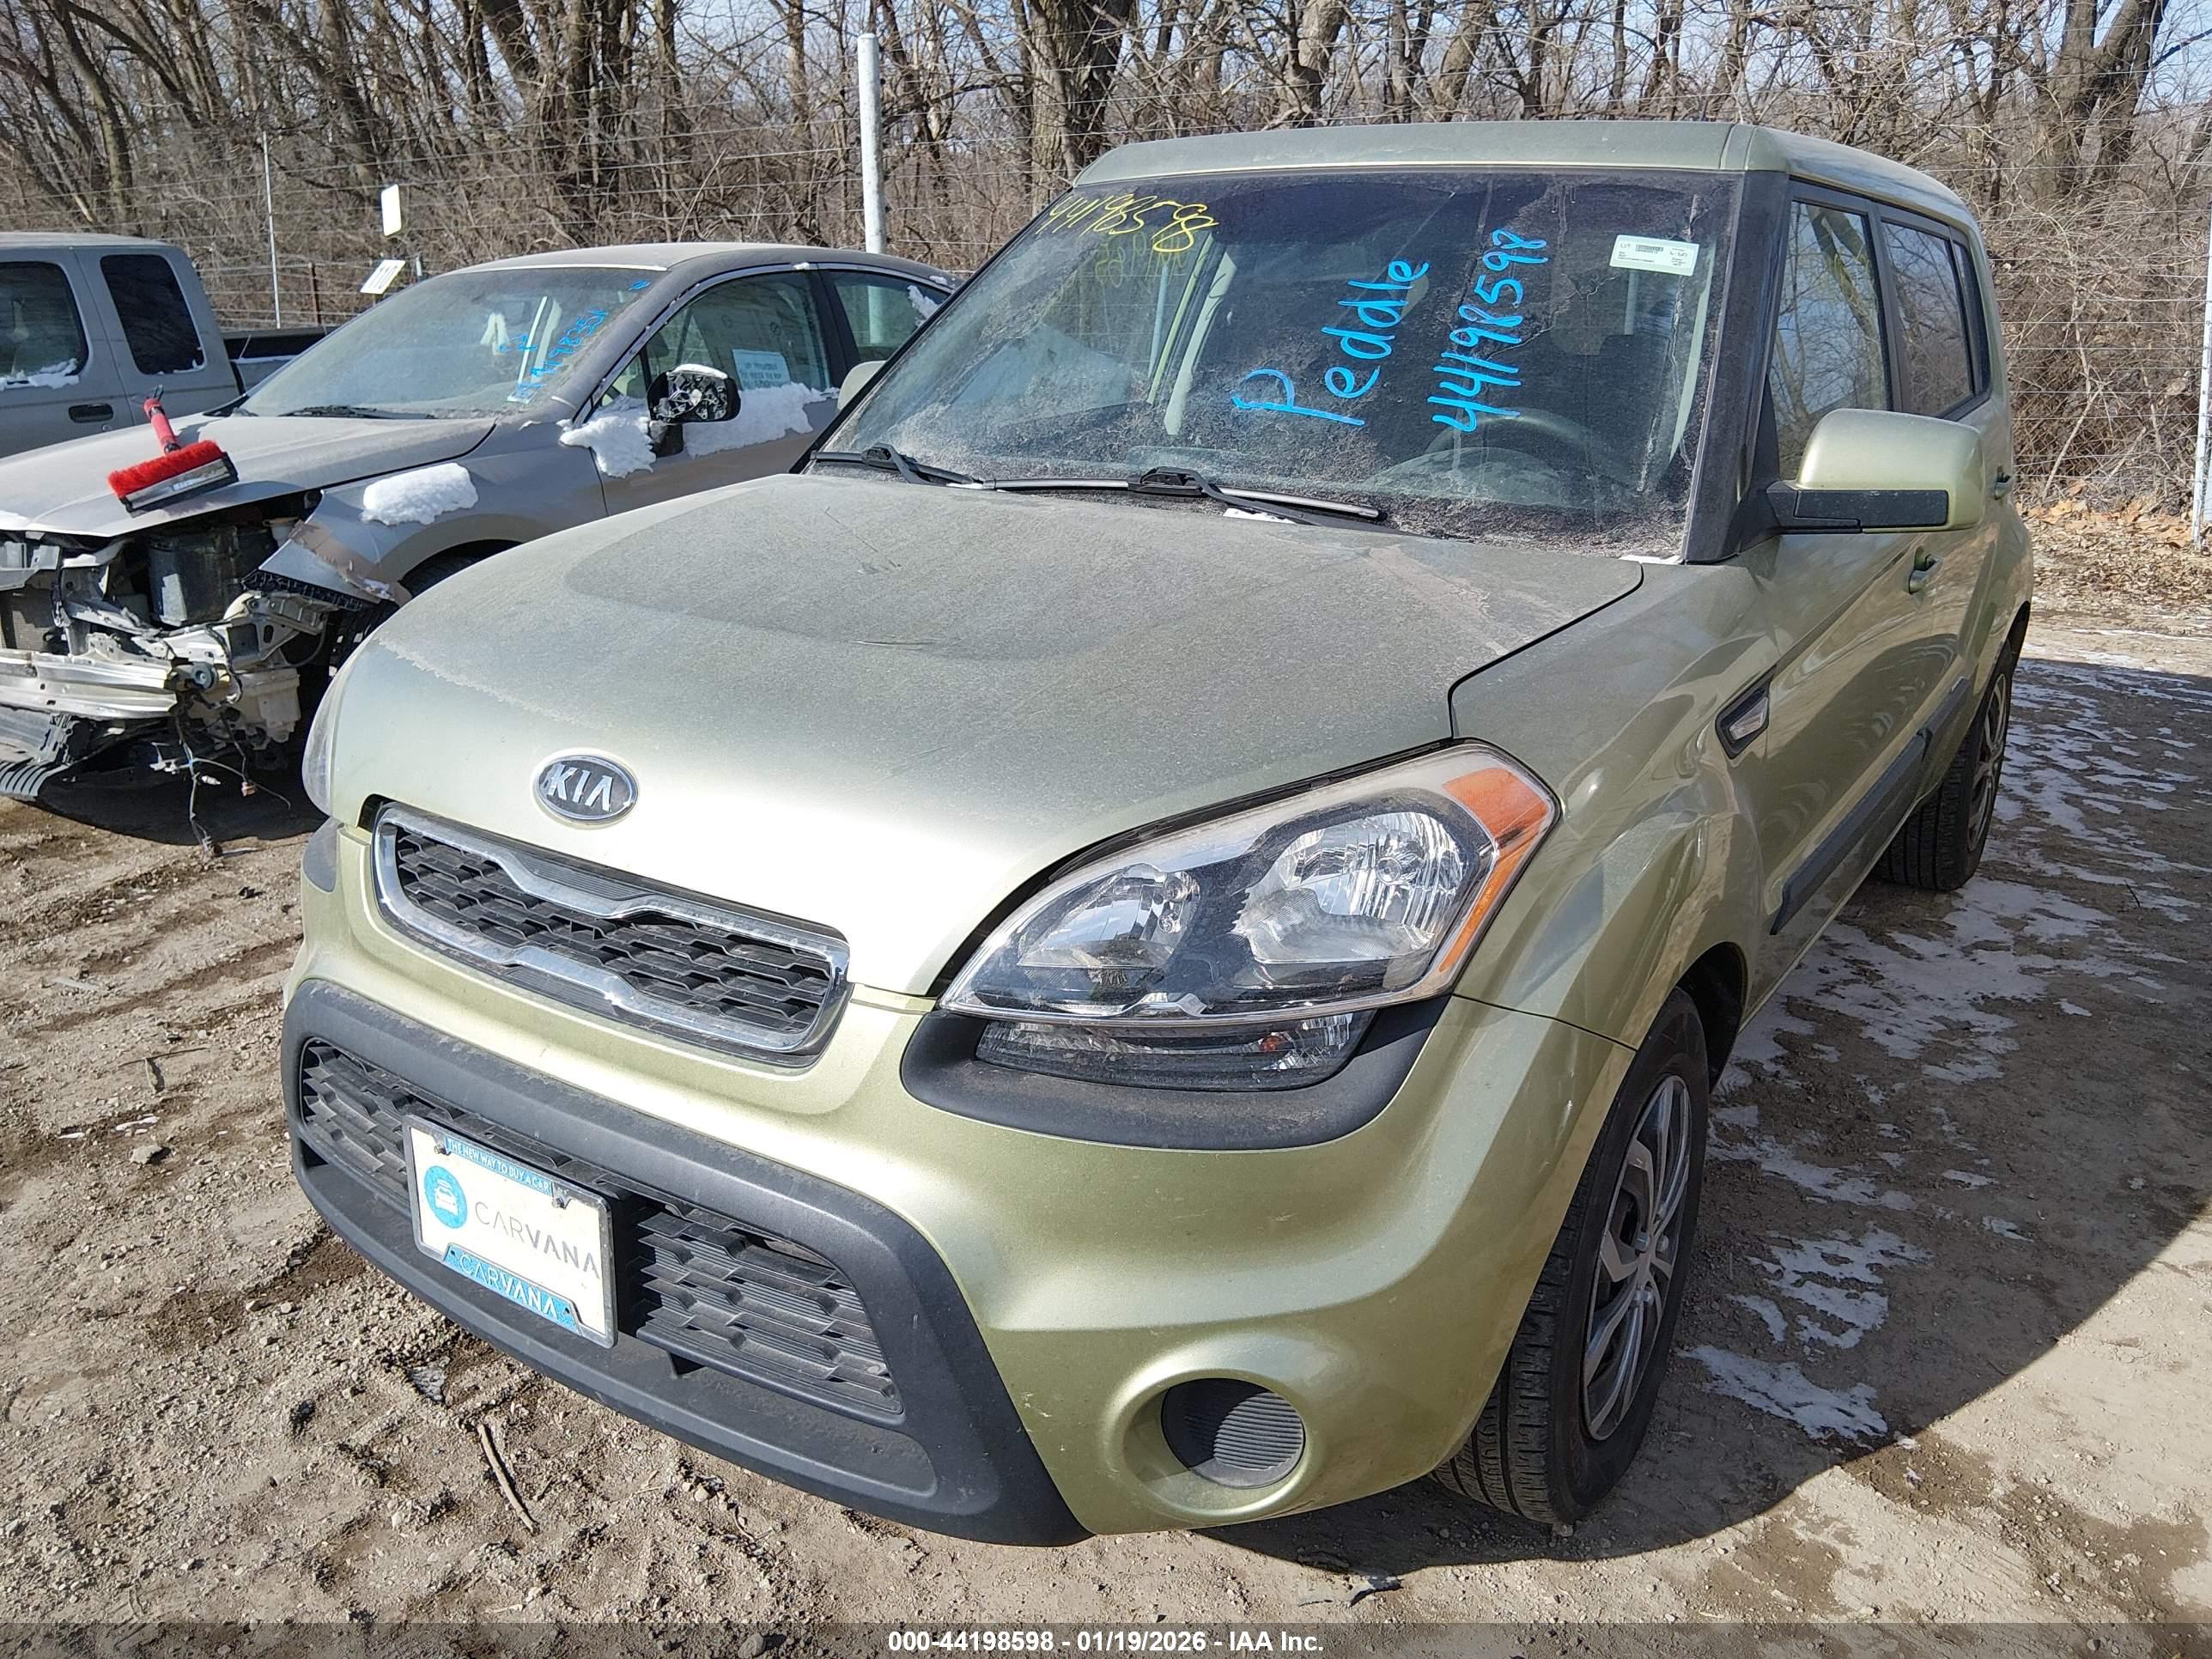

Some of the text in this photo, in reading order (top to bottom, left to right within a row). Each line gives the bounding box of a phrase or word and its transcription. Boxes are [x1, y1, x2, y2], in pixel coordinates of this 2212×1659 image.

[1231, 260, 1429, 426] Peddle
[1427, 228, 1549, 432] 44198598
[547, 763, 613, 811] KIA
[447, 1138, 463, 1152] THE
[464, 1145, 481, 1162] NEW
[481, 1153, 496, 1169] WAY
[497, 1161, 508, 1174] TO
[475, 1201, 600, 1279] CARVANA
[459, 1254, 558, 1319] CARVANA
